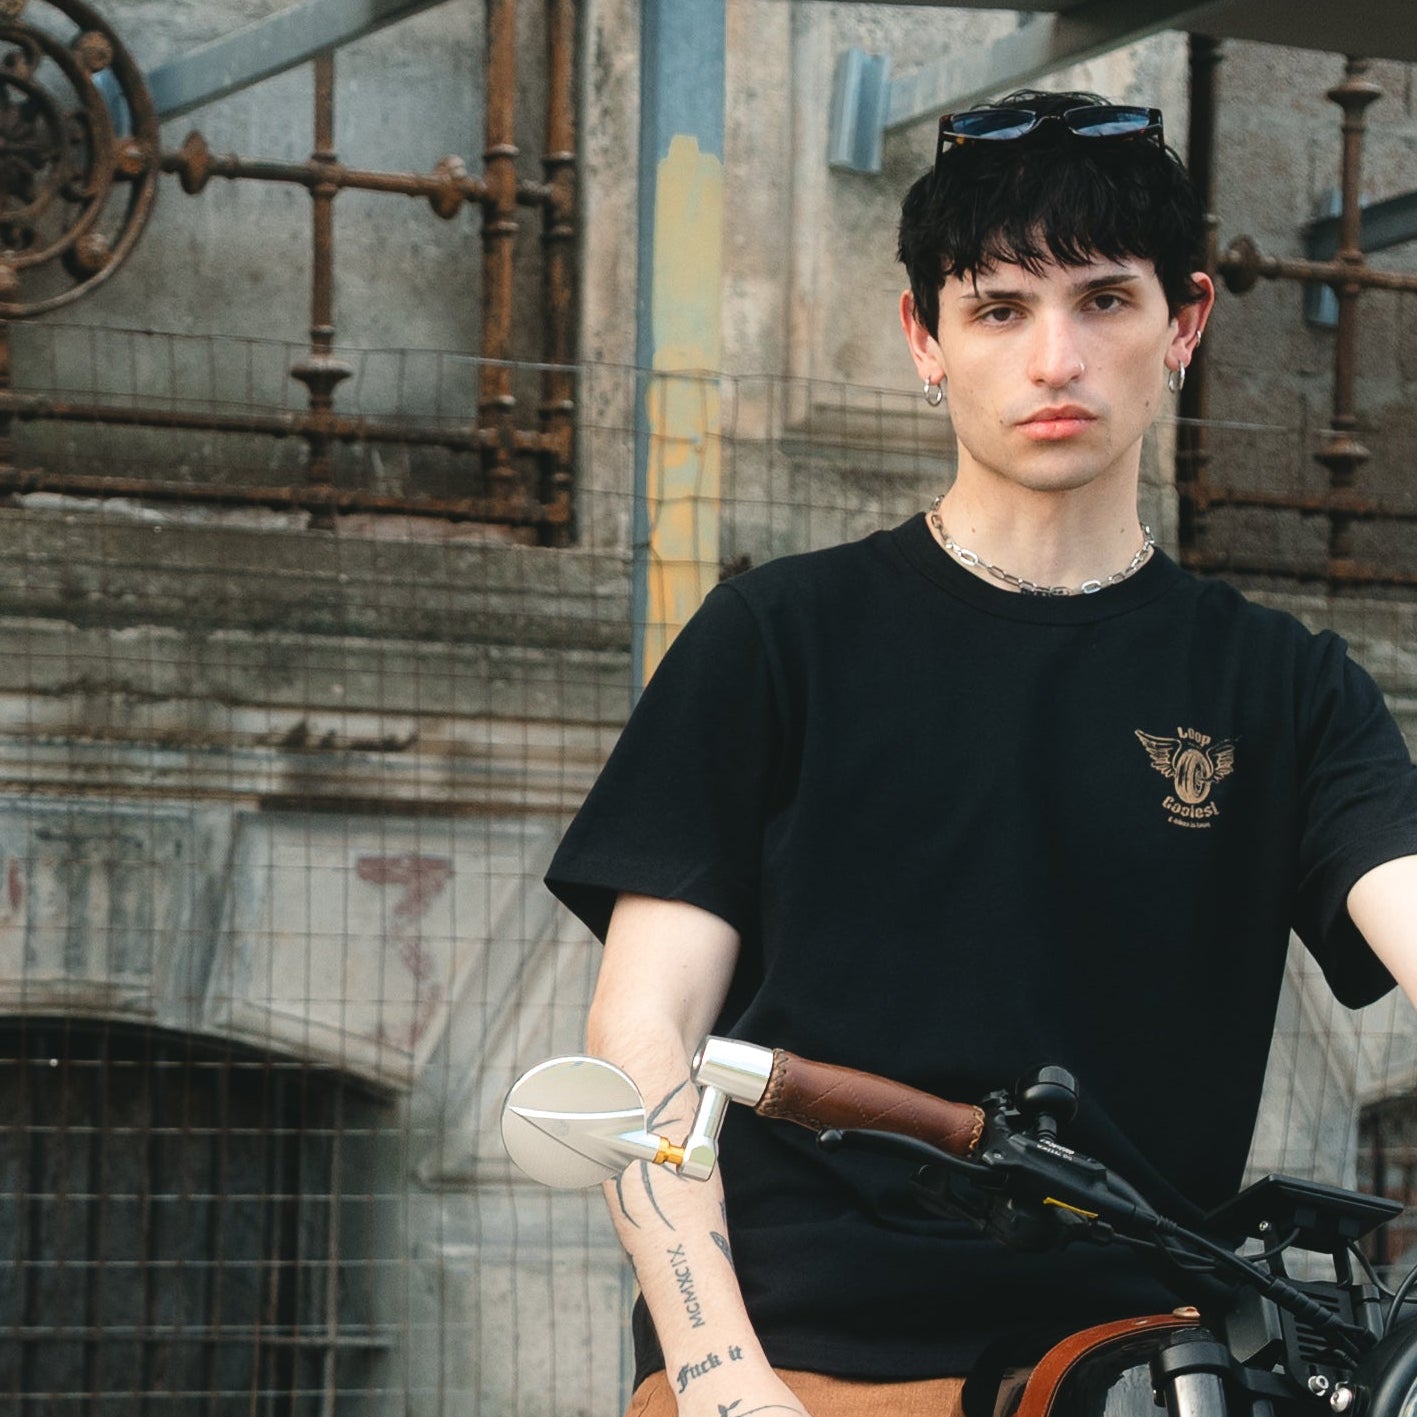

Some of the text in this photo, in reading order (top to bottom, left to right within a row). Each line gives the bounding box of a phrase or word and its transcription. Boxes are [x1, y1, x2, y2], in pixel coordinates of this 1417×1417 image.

[1177, 726, 1211, 747] Loop
[667, 1243, 705, 1329] MCMXCIX
[677, 1345, 744, 1394] Fuck it
